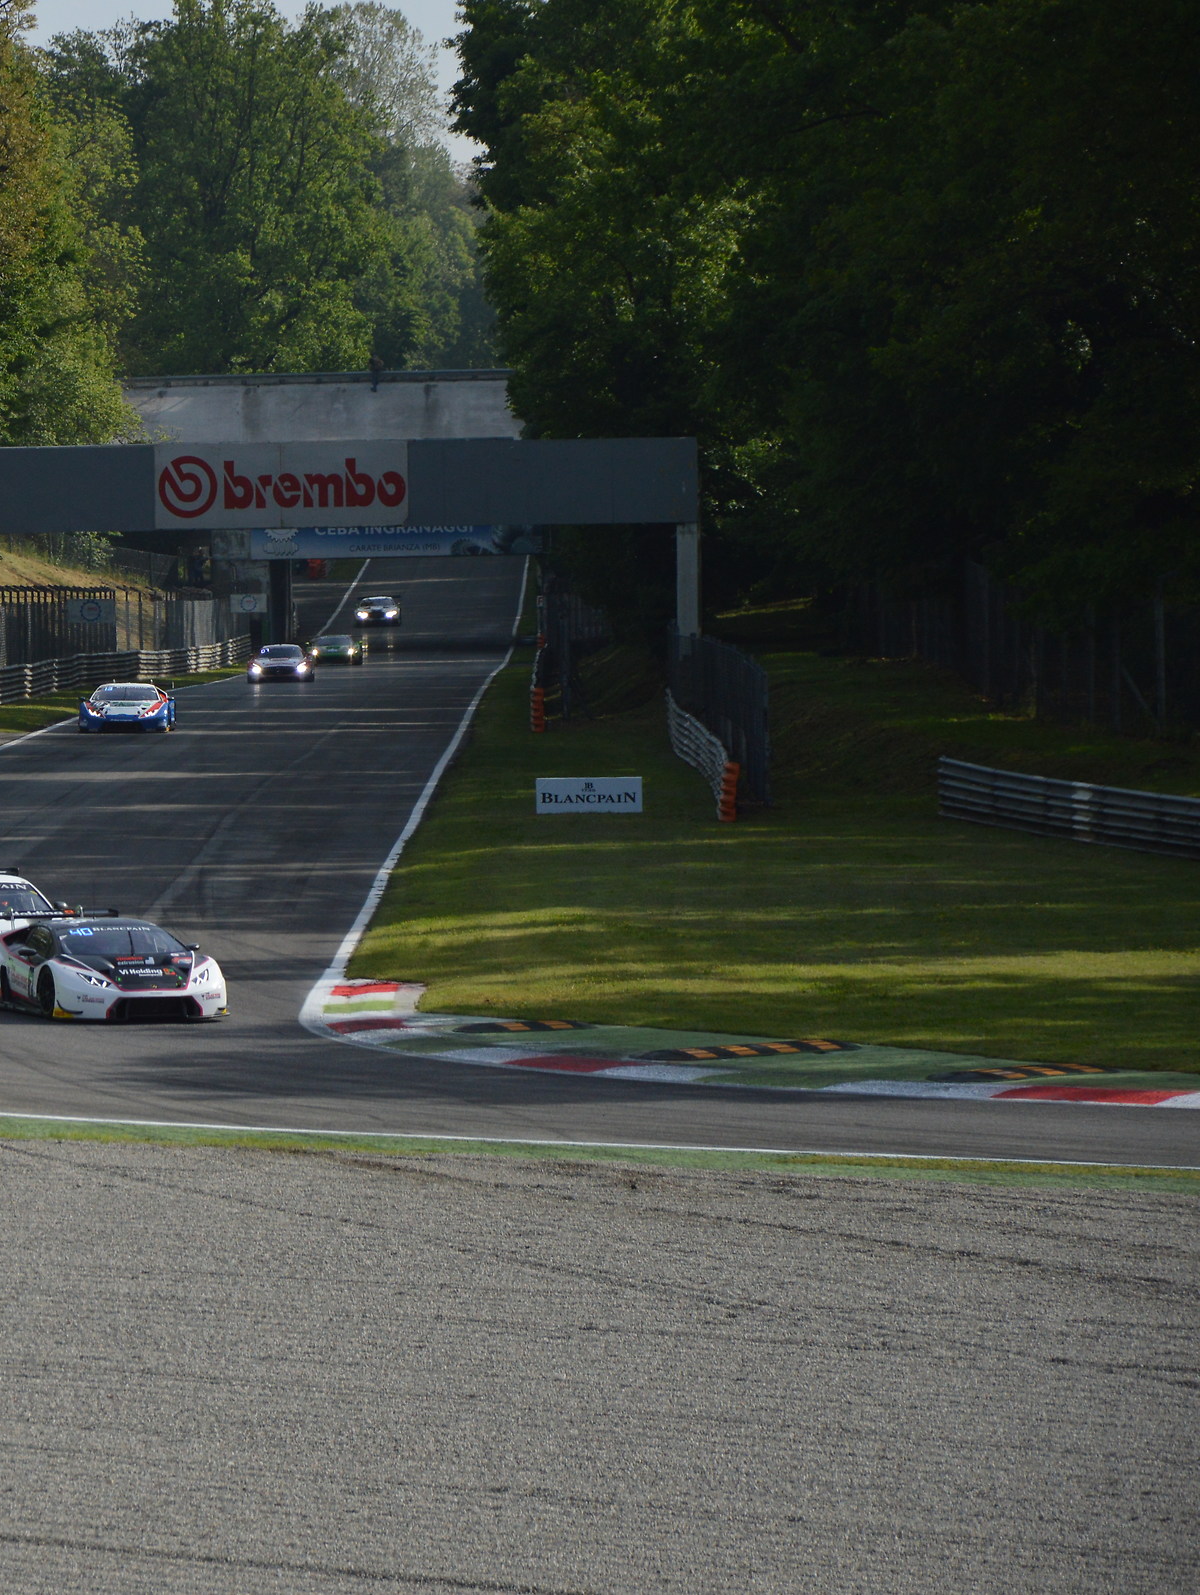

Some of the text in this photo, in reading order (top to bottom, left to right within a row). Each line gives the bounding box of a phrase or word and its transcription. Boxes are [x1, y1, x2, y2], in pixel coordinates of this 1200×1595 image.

[223, 457, 406, 510] brembo
[314, 527, 362, 536] CEBA
[350, 544, 382, 553] CARATE
[384, 543, 421, 552] BRIANZA
[541, 792, 636, 804] BLANCPAIN
[69, 927, 94, 937] 40
